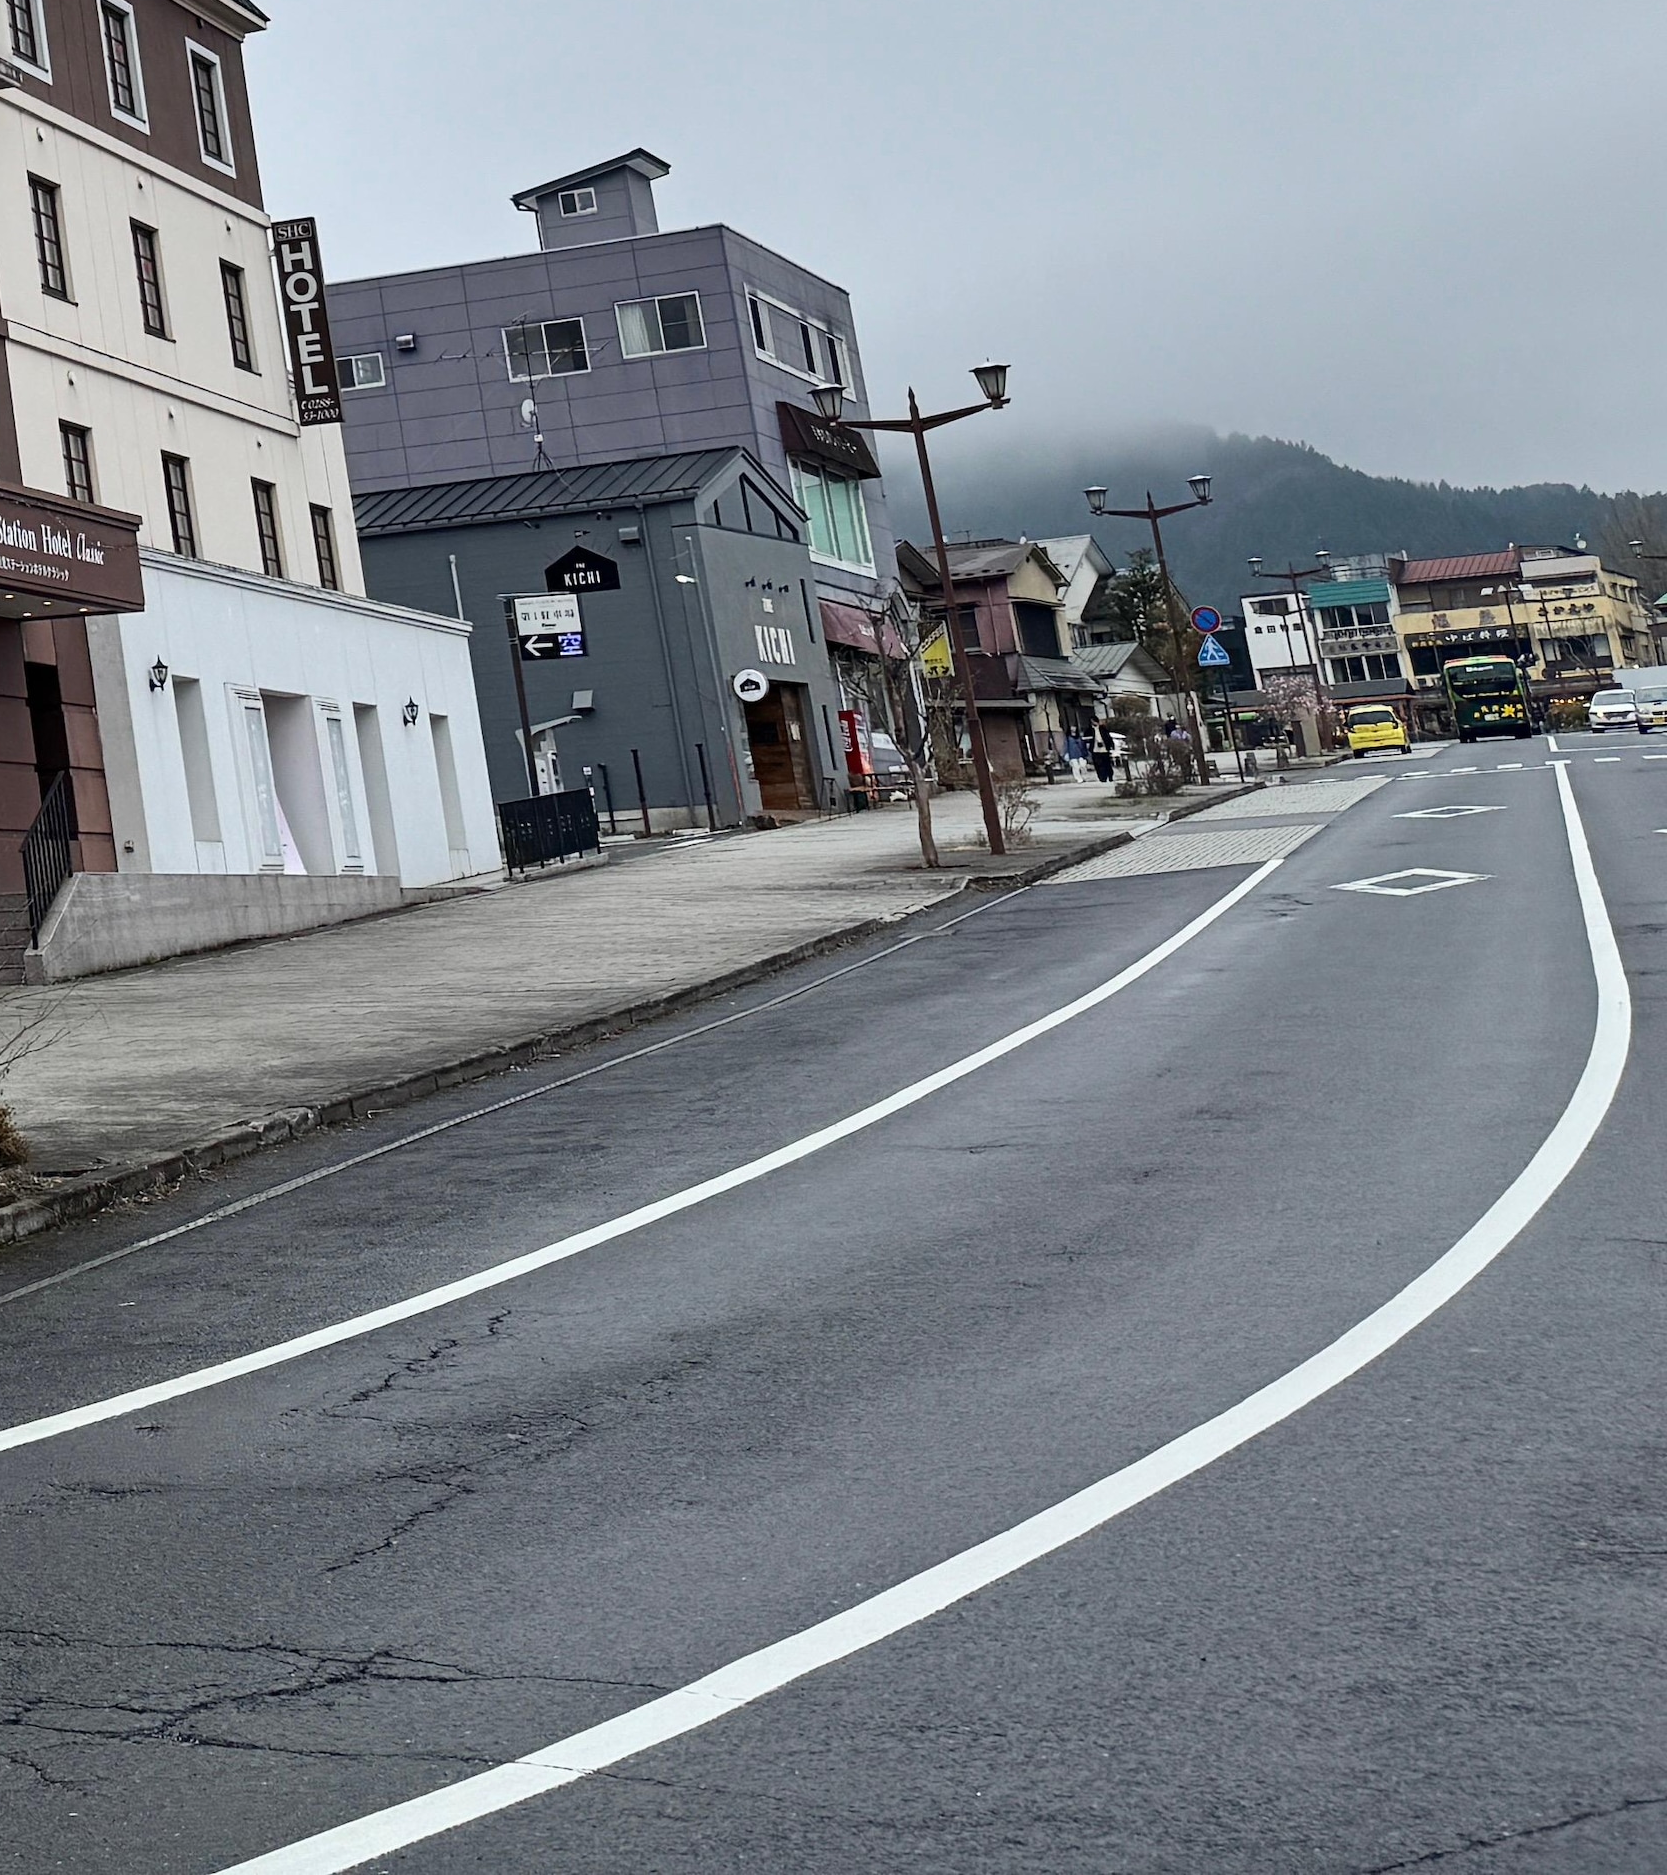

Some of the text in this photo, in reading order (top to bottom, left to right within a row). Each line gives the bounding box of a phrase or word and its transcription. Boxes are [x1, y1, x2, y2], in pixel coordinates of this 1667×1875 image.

[278, 223, 311, 240] SHC
[280, 240, 330, 395] HOTEL
[40, 523, 73, 559] Hotel
[76, 532, 105, 566] Classic
[563, 570, 601, 586] KICHI
[557, 633, 584, 656] 空
[754, 624, 796, 665] KICHI
